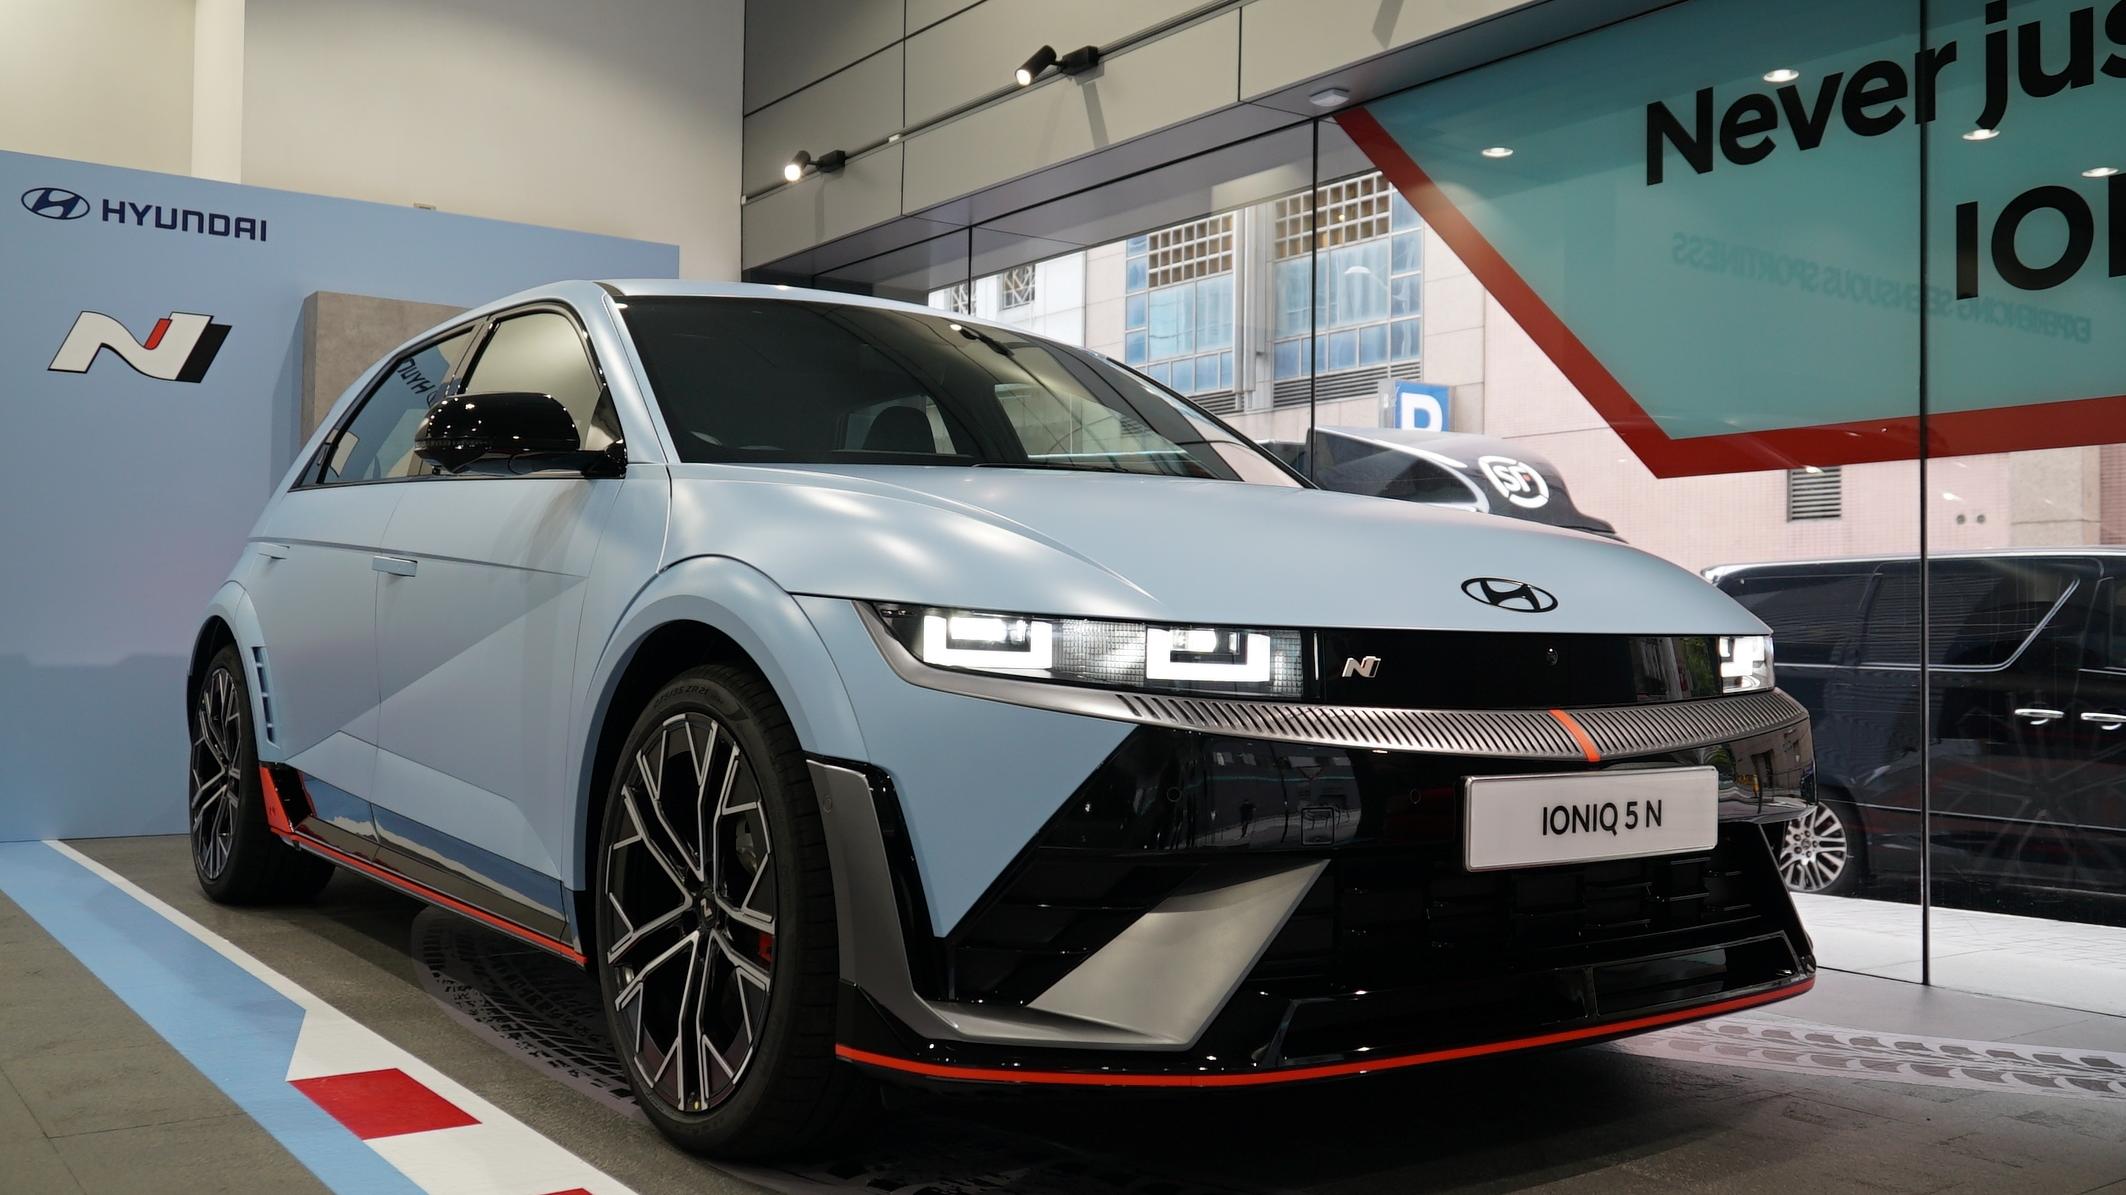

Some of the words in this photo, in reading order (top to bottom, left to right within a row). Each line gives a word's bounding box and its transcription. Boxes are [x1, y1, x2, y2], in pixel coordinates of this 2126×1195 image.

[1646, 40, 1957, 186] Never
[102, 199, 267, 241] HYUNDAI
[1542, 802, 1618, 836] IONIQ
[1624, 801, 1639, 830] 5
[1645, 799, 1662, 828] N
